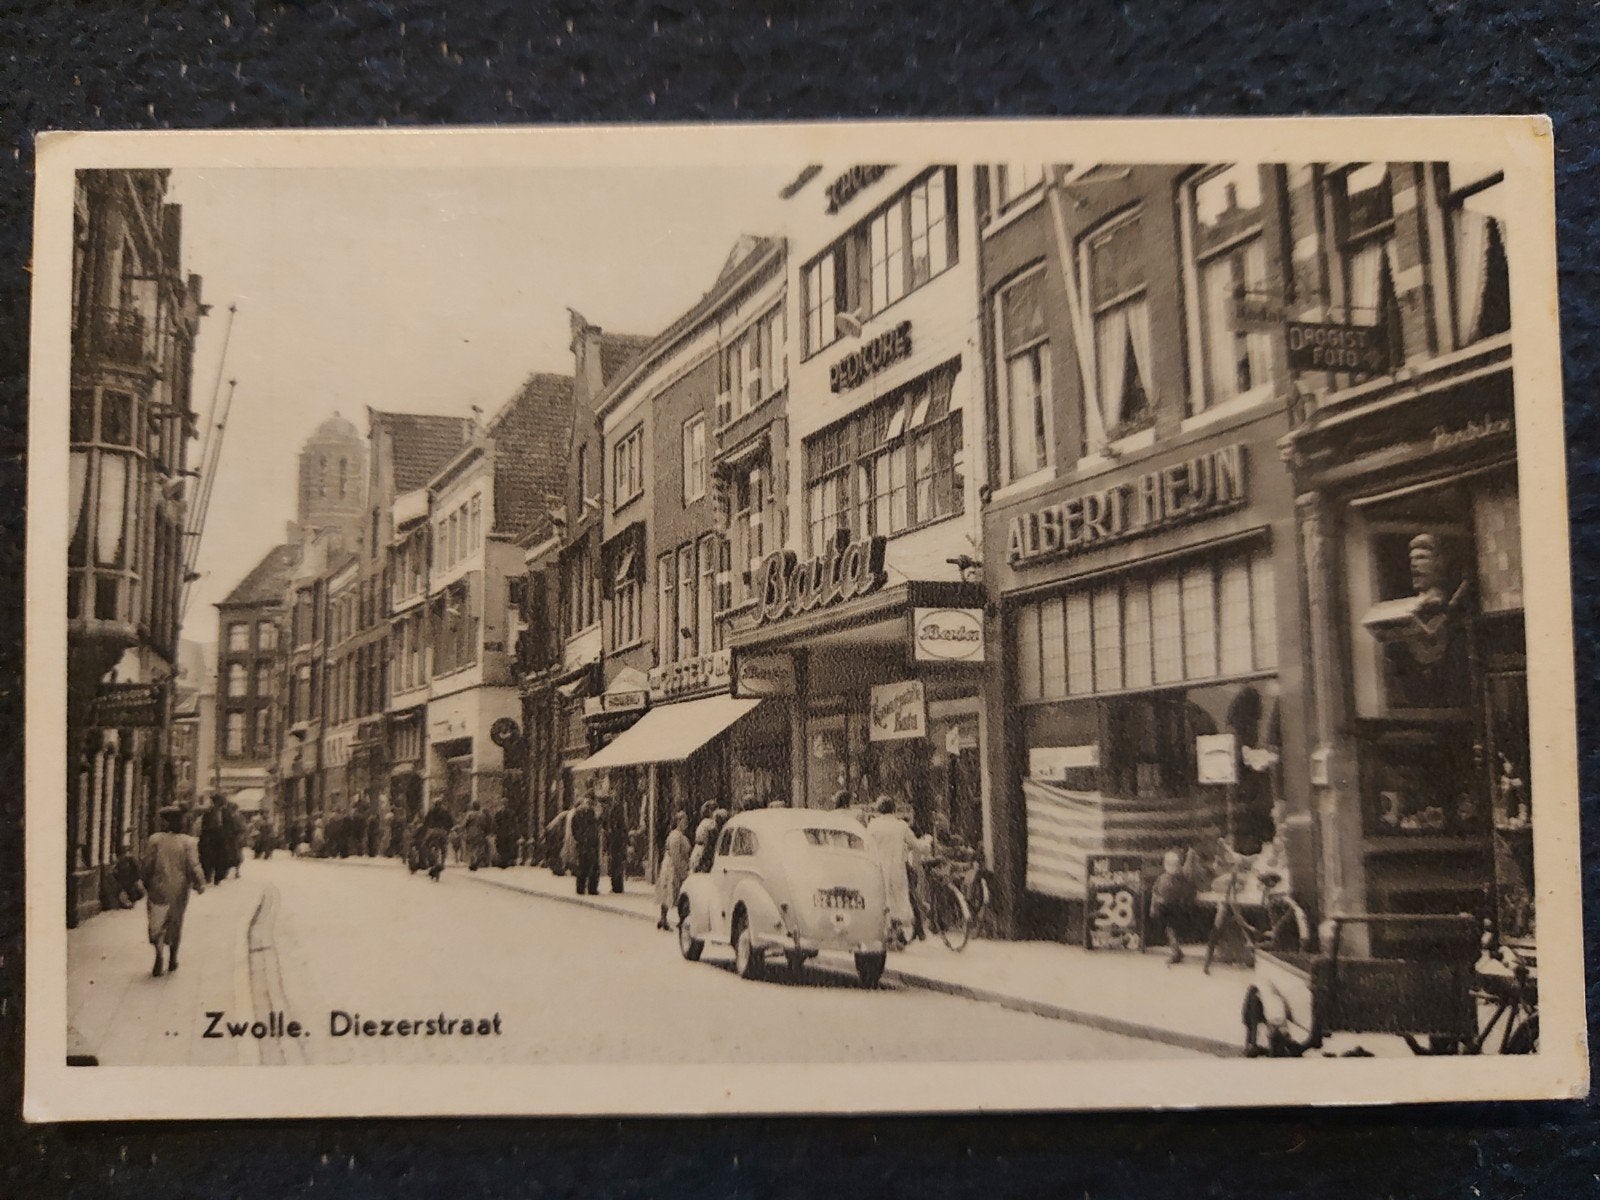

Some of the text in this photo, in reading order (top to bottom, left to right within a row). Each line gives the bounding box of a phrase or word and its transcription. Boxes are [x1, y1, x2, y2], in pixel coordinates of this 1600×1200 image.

[830, 320, 912, 394] PEDICURE
[1007, 483, 1132, 568] ALBERT
[752, 538, 885, 622] Bata
[920, 624, 979, 641] Bata
